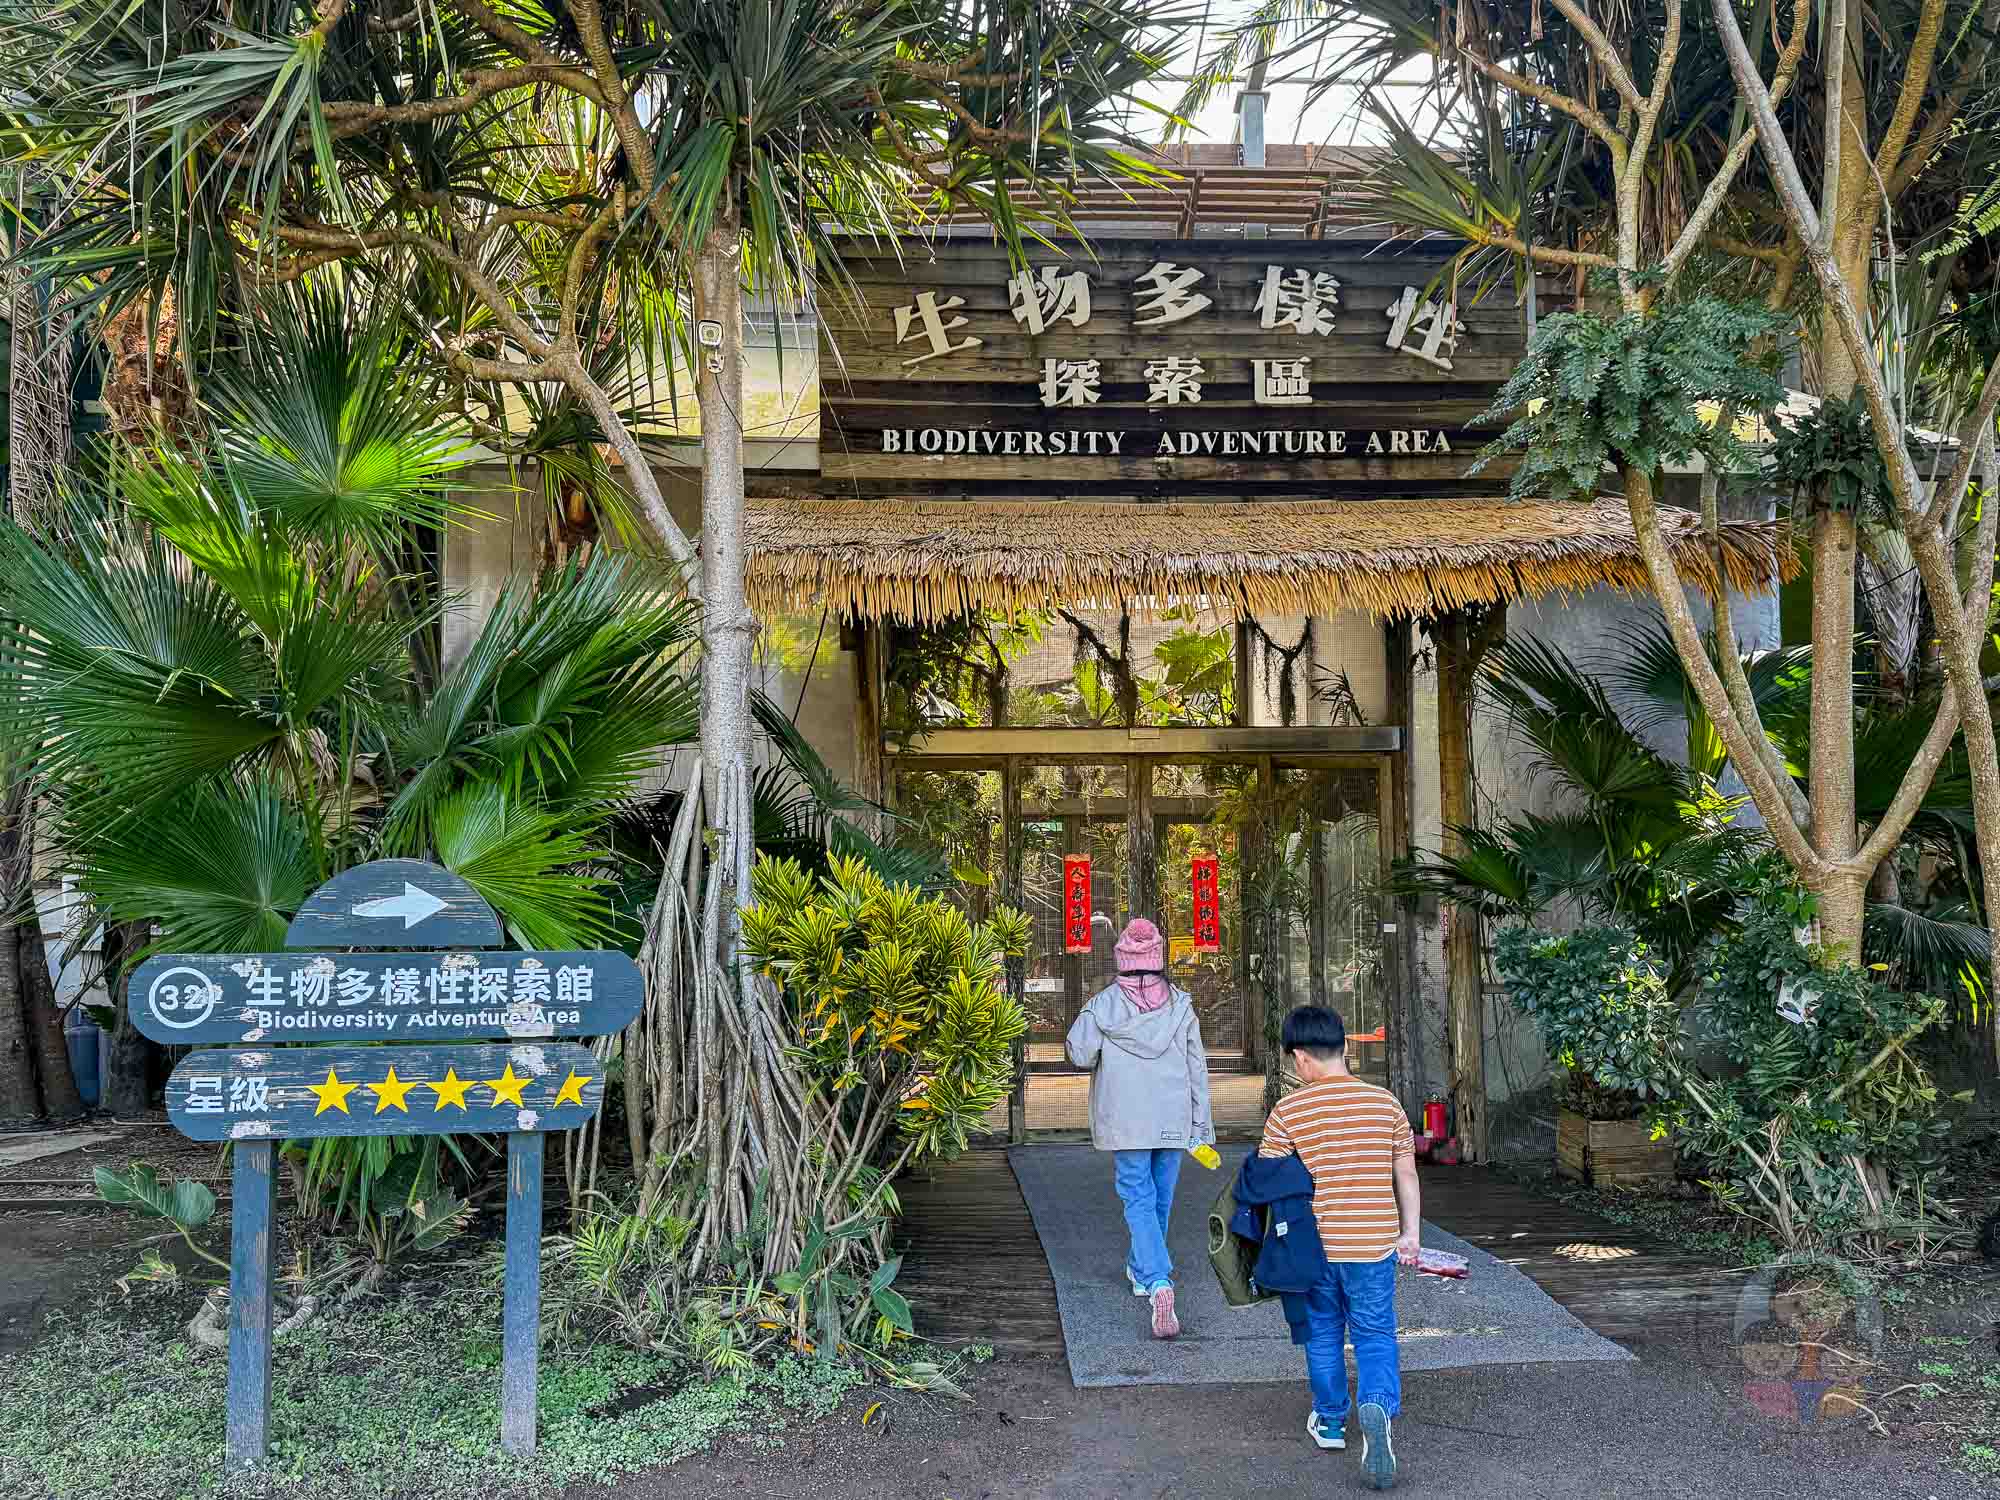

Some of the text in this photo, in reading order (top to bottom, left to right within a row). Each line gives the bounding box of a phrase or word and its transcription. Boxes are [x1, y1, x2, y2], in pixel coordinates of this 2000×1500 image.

[893, 262, 1467, 371] 生物多樣性
[1039, 356, 1313, 408] 探索區
[881, 428, 1452, 455] BIODIVERSITY ADVENTURE AREA
[159, 984, 204, 1011] 32
[245, 964, 594, 1007] 生物多樣性探索館
[257, 1007, 581, 1030] Biodiversity Adventure Area
